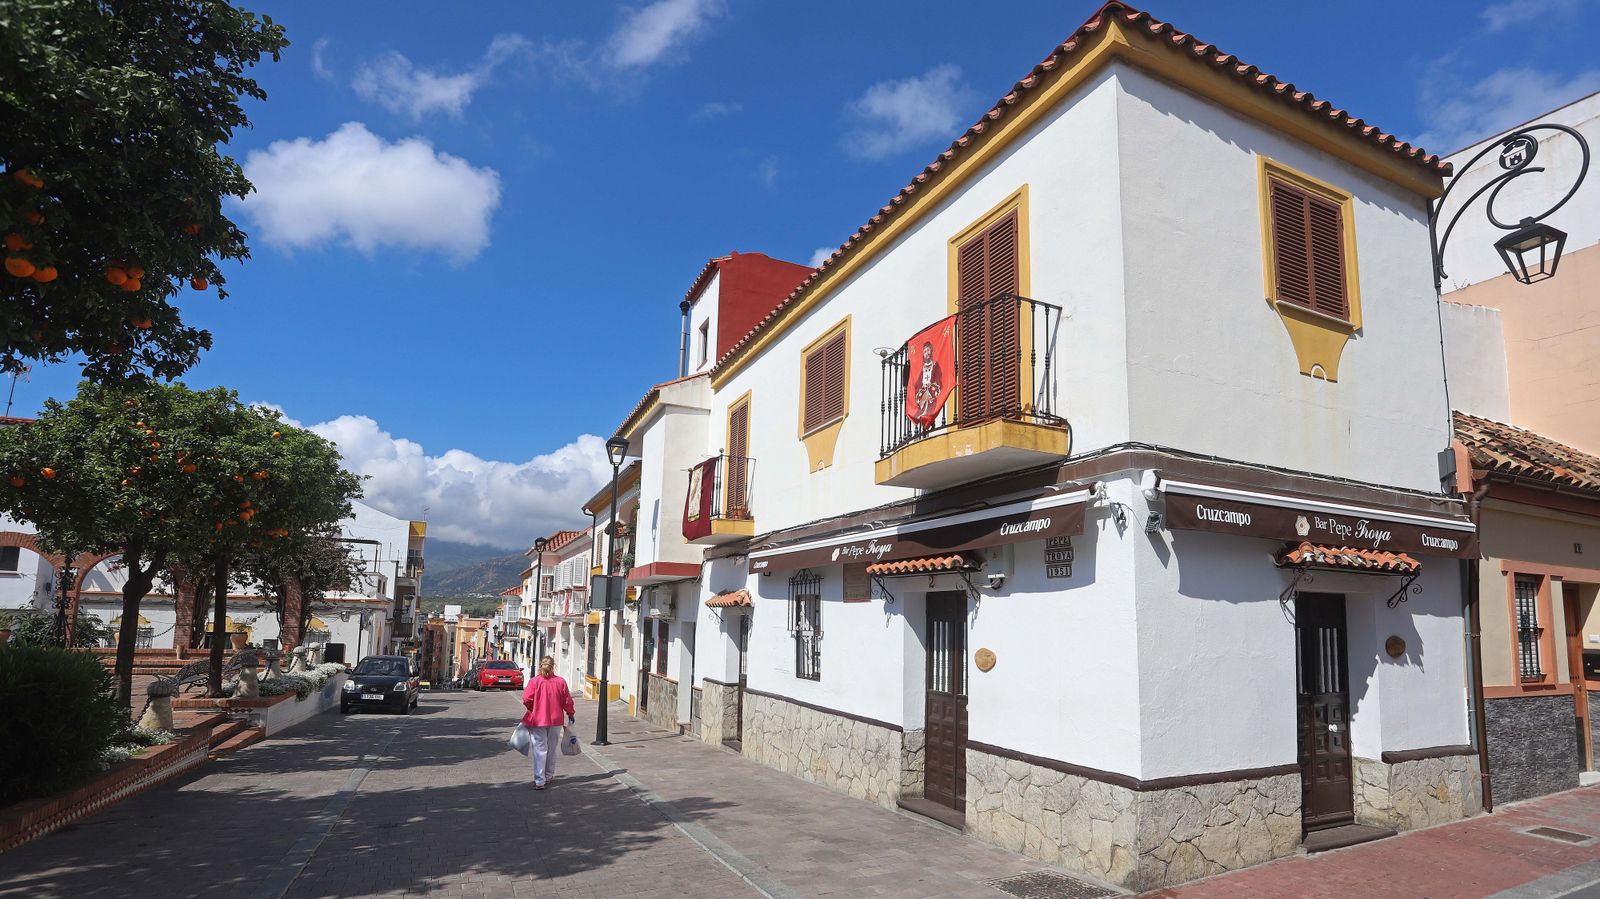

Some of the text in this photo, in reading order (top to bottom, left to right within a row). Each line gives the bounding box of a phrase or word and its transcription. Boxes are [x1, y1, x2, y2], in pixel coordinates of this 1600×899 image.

[1196, 504, 1251, 527] Cruzcampo
[1000, 517, 1051, 536] Cruzcampo
[1314, 516, 1392, 548] Bar Pepe Troya
[1048, 535, 1069, 545] PEPE
[1421, 533, 1459, 551] Cruzcampo
[848, 545, 865, 559] Pepe
[865, 539, 893, 560] Troya
[1047, 551, 1071, 561] TROYA
[1050, 566, 1069, 576] 1951
